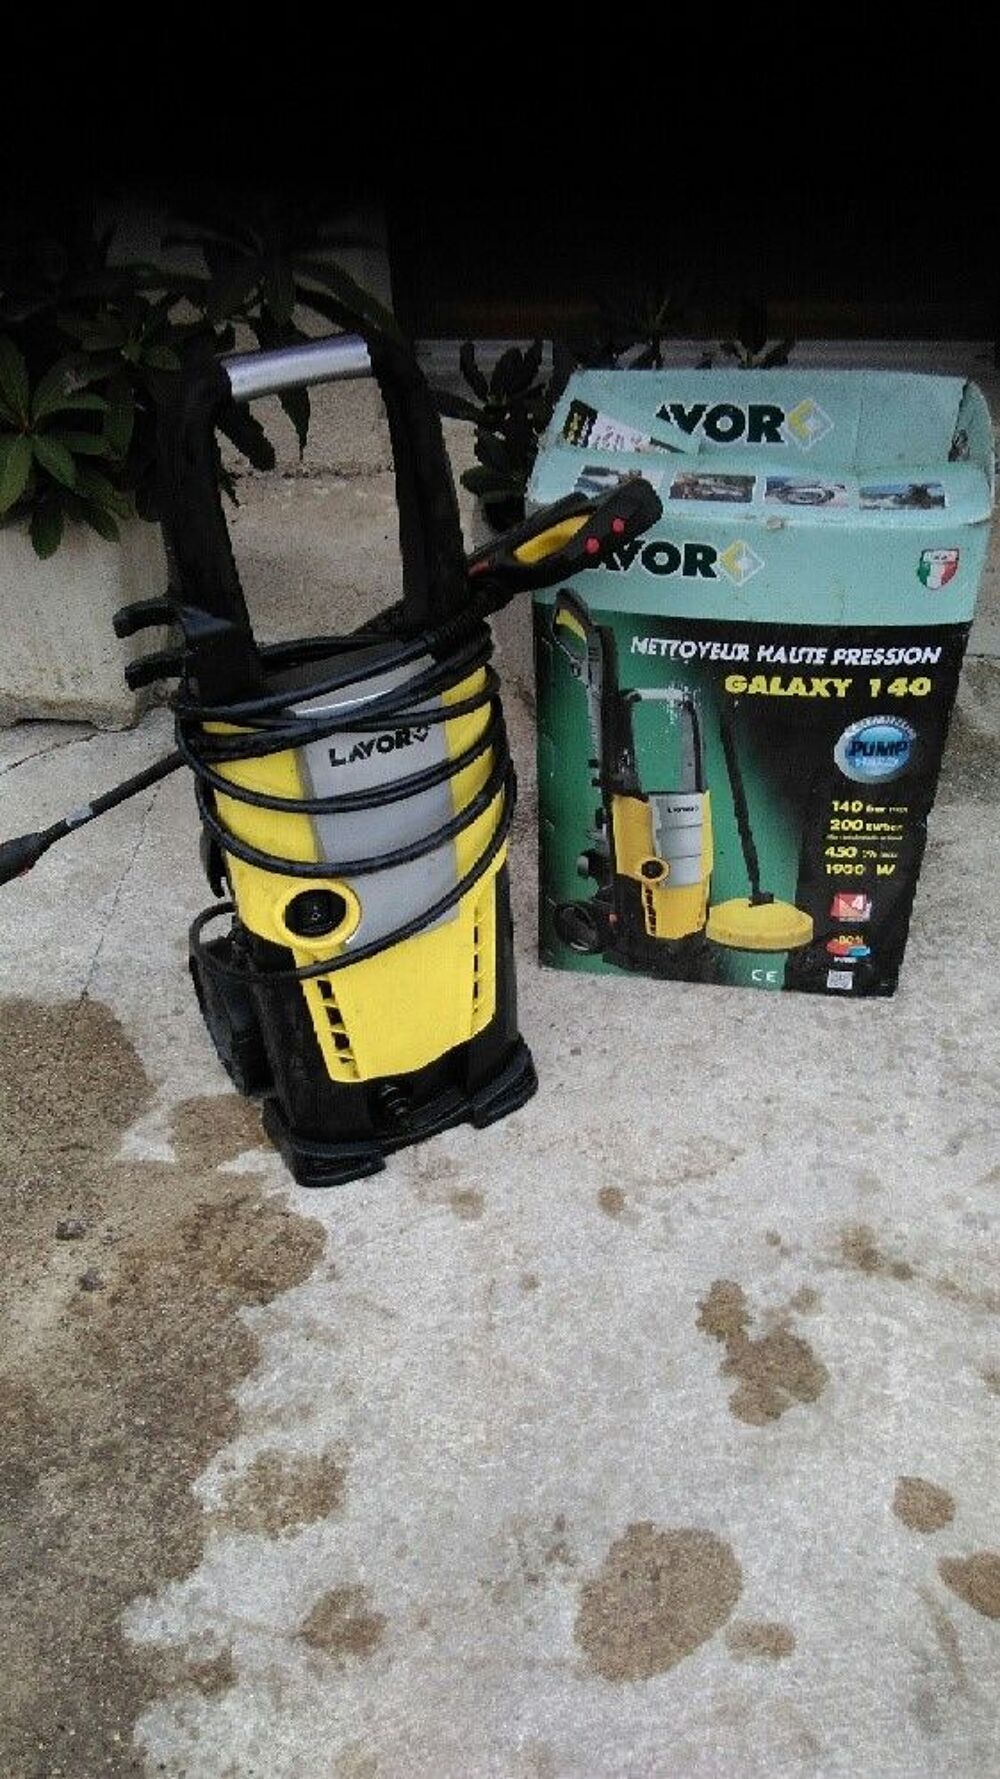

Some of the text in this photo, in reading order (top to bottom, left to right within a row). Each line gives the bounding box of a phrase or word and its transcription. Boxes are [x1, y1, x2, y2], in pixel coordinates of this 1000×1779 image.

[630, 636, 942, 666] NETTOYEUR HAUTE PRESSION
[725, 675, 931, 697] GALAXY 140
[329, 728, 414, 767] LAVOR
[847, 740, 908, 756] PUMP
[832, 800, 864, 813] 140
[830, 820, 863, 831] 200
[825, 847, 858, 858] 450
[877, 864, 896, 875] W
